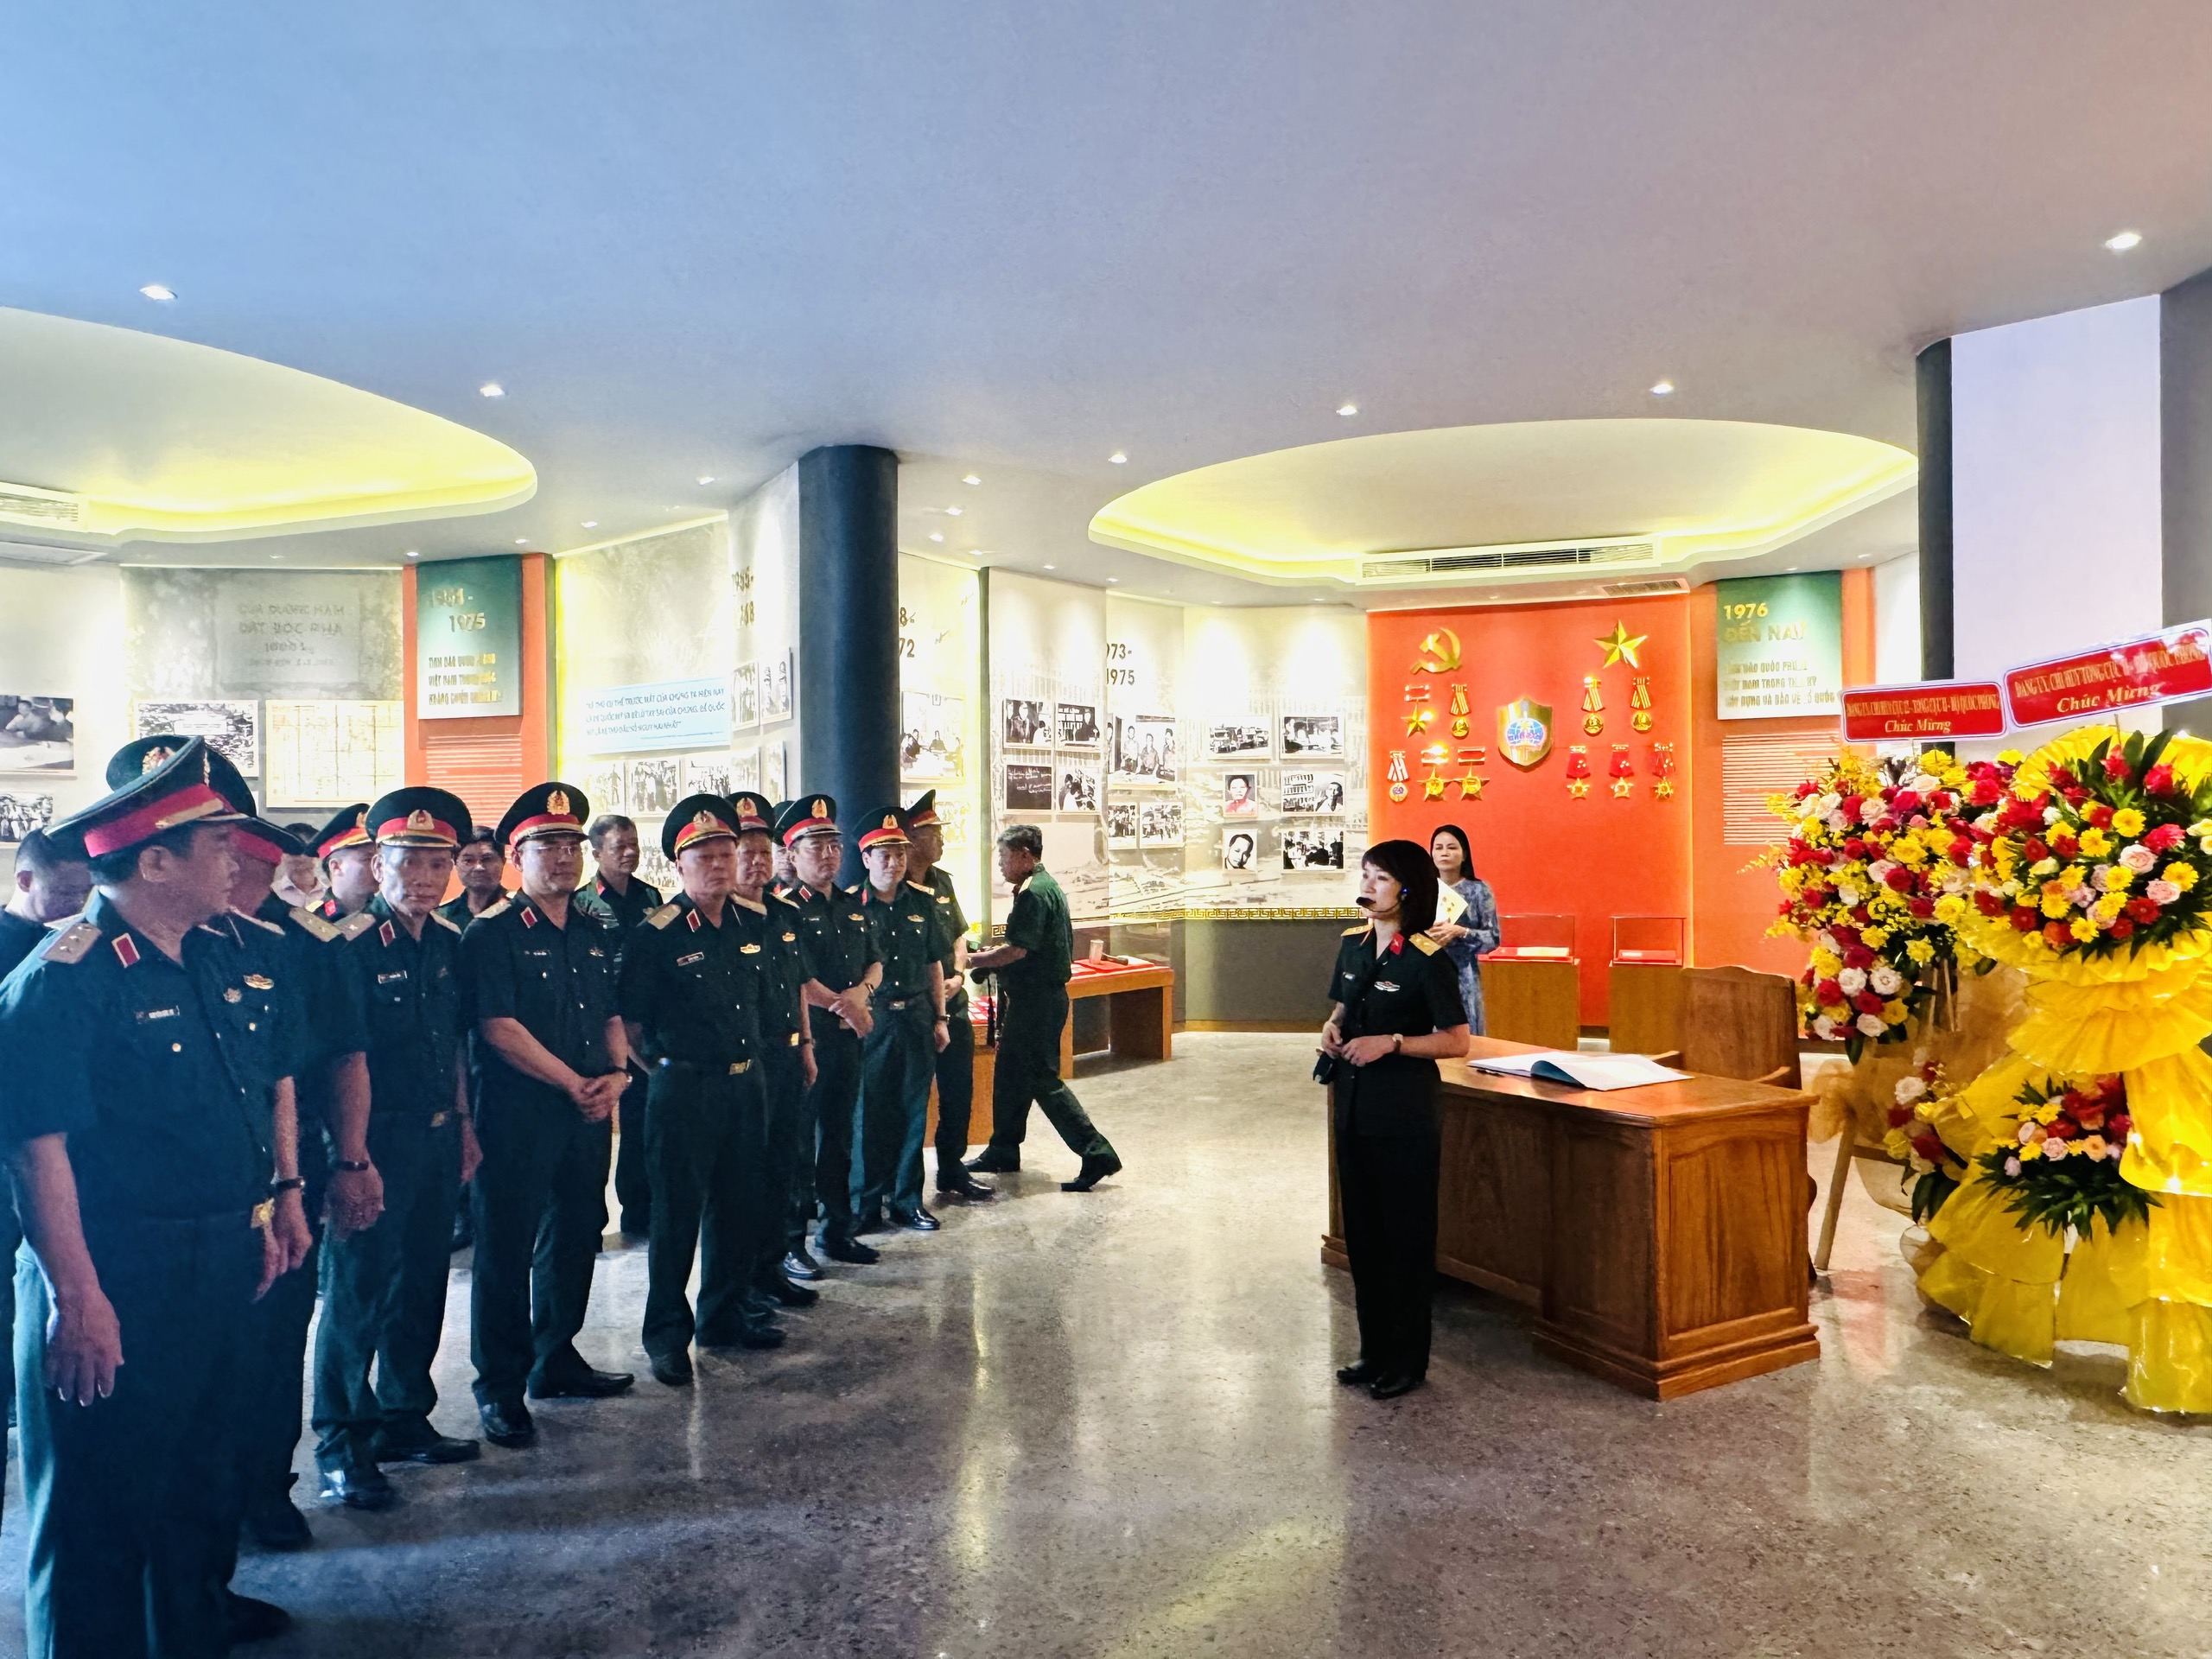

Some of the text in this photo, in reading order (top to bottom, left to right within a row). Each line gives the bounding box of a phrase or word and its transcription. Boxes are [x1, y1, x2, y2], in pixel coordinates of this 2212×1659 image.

[1723, 602, 1769, 620] 1976
[1106, 668, 1135, 685] 1975
[2056, 693, 2100, 714] Chúc
[1885, 718, 1952, 734] Chúc Mừng
